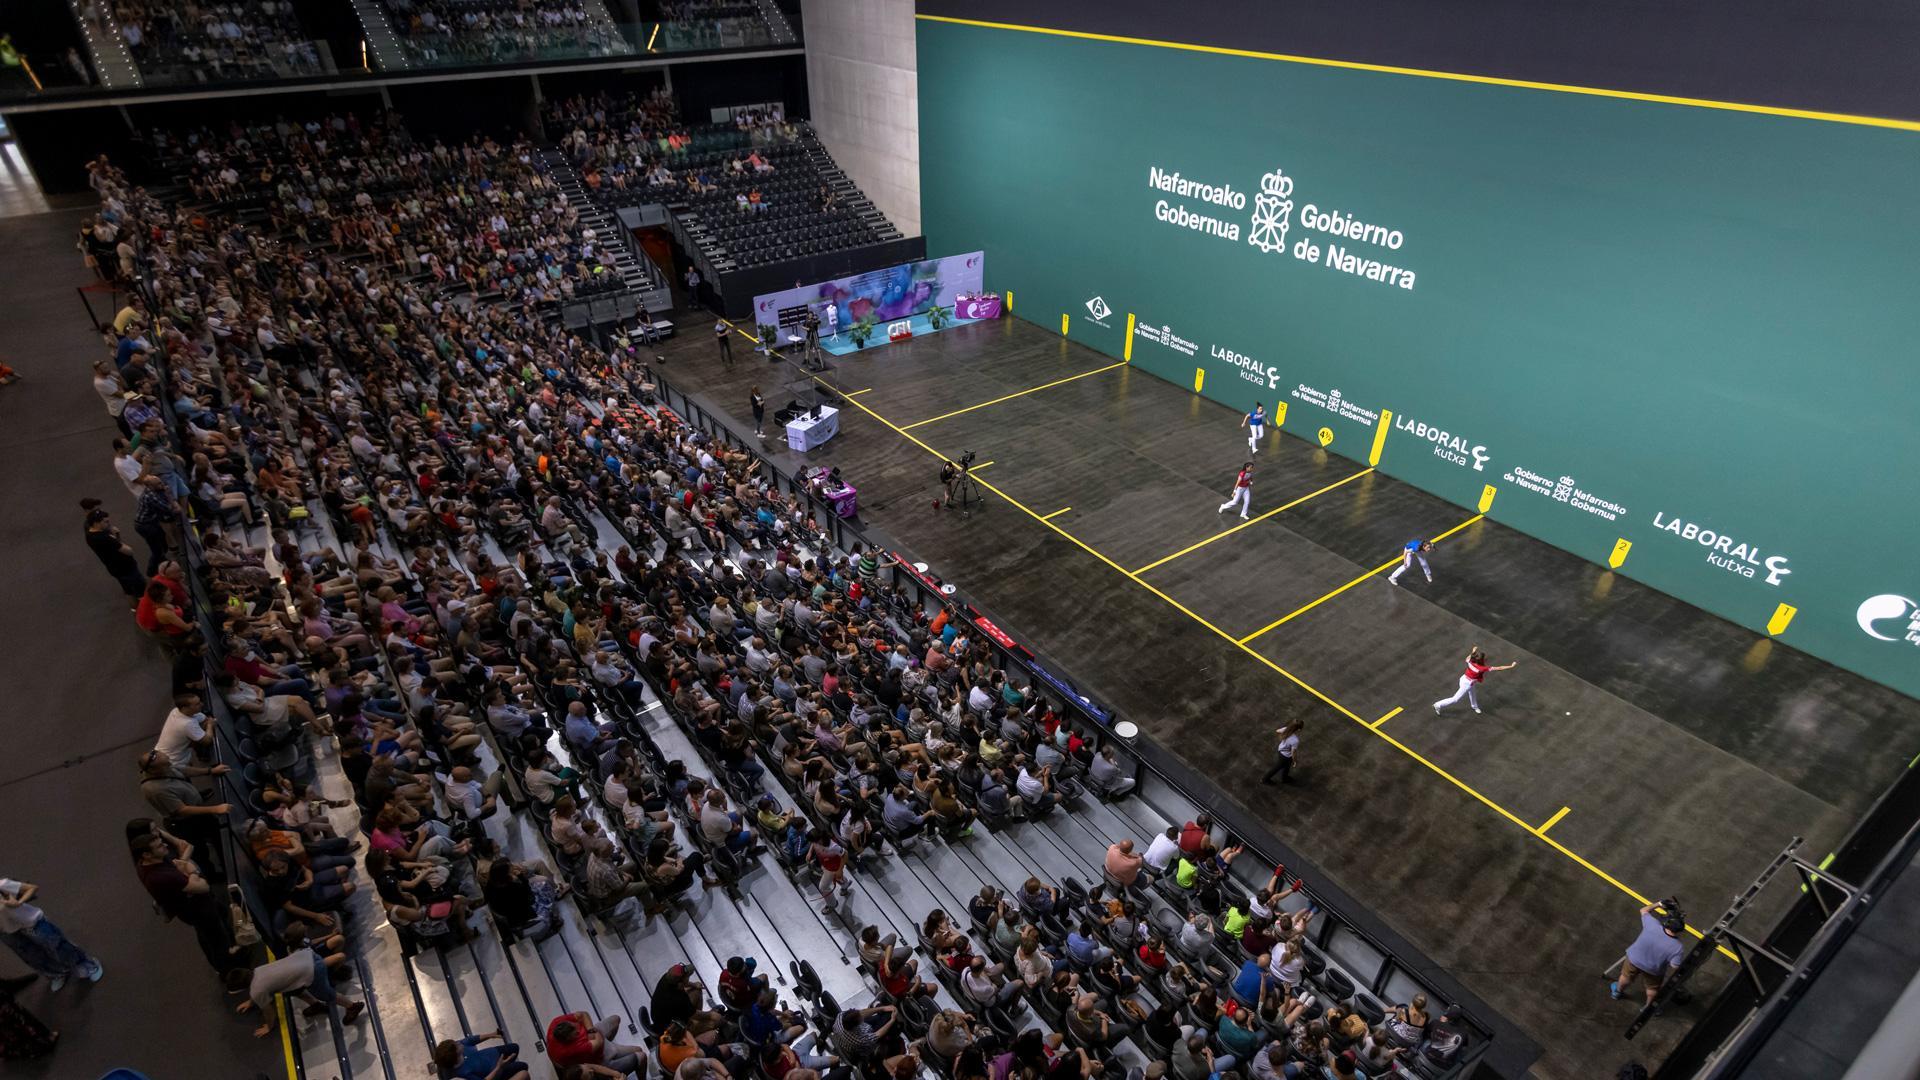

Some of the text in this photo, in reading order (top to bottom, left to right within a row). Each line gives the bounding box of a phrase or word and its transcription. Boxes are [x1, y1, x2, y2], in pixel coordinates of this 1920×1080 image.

[1149, 166, 1246, 210] Nafarroako
[1155, 200, 1240, 241] Gobernua
[1300, 204, 1403, 250] Gobierno
[1294, 238, 1416, 290] de Navarra
[1139, 322, 1160, 336] Gobierno
[1141, 330, 1160, 343] Navarra
[1170, 341, 1195, 356] Gobernua
[1171, 334, 1198, 351] Nafarroako
[1211, 344, 1266, 376] LABORAL
[1240, 370, 1264, 386] kutxa
[1291, 389, 1326, 408] de Navarra
[1298, 384, 1327, 400] Gobierno
[1339, 407, 1372, 426] Gobernua
[1341, 400, 1378, 420] Nafarroako
[1396, 414, 1469, 455] LABORAL
[1434, 445, 1466, 466] kutxa
[1504, 472, 1550, 496] de Navarra
[1514, 466, 1554, 488] Gobierno
[1487, 487, 1493, 496] 3
[1573, 488, 1626, 515] Nafarroako
[1570, 498, 1616, 521] Gobernua
[1618, 541, 1627, 552] 2
[1652, 511, 1760, 566] LABORAL
[1706, 552, 1755, 579] kutxa
[1783, 607, 1790, 616] 1
